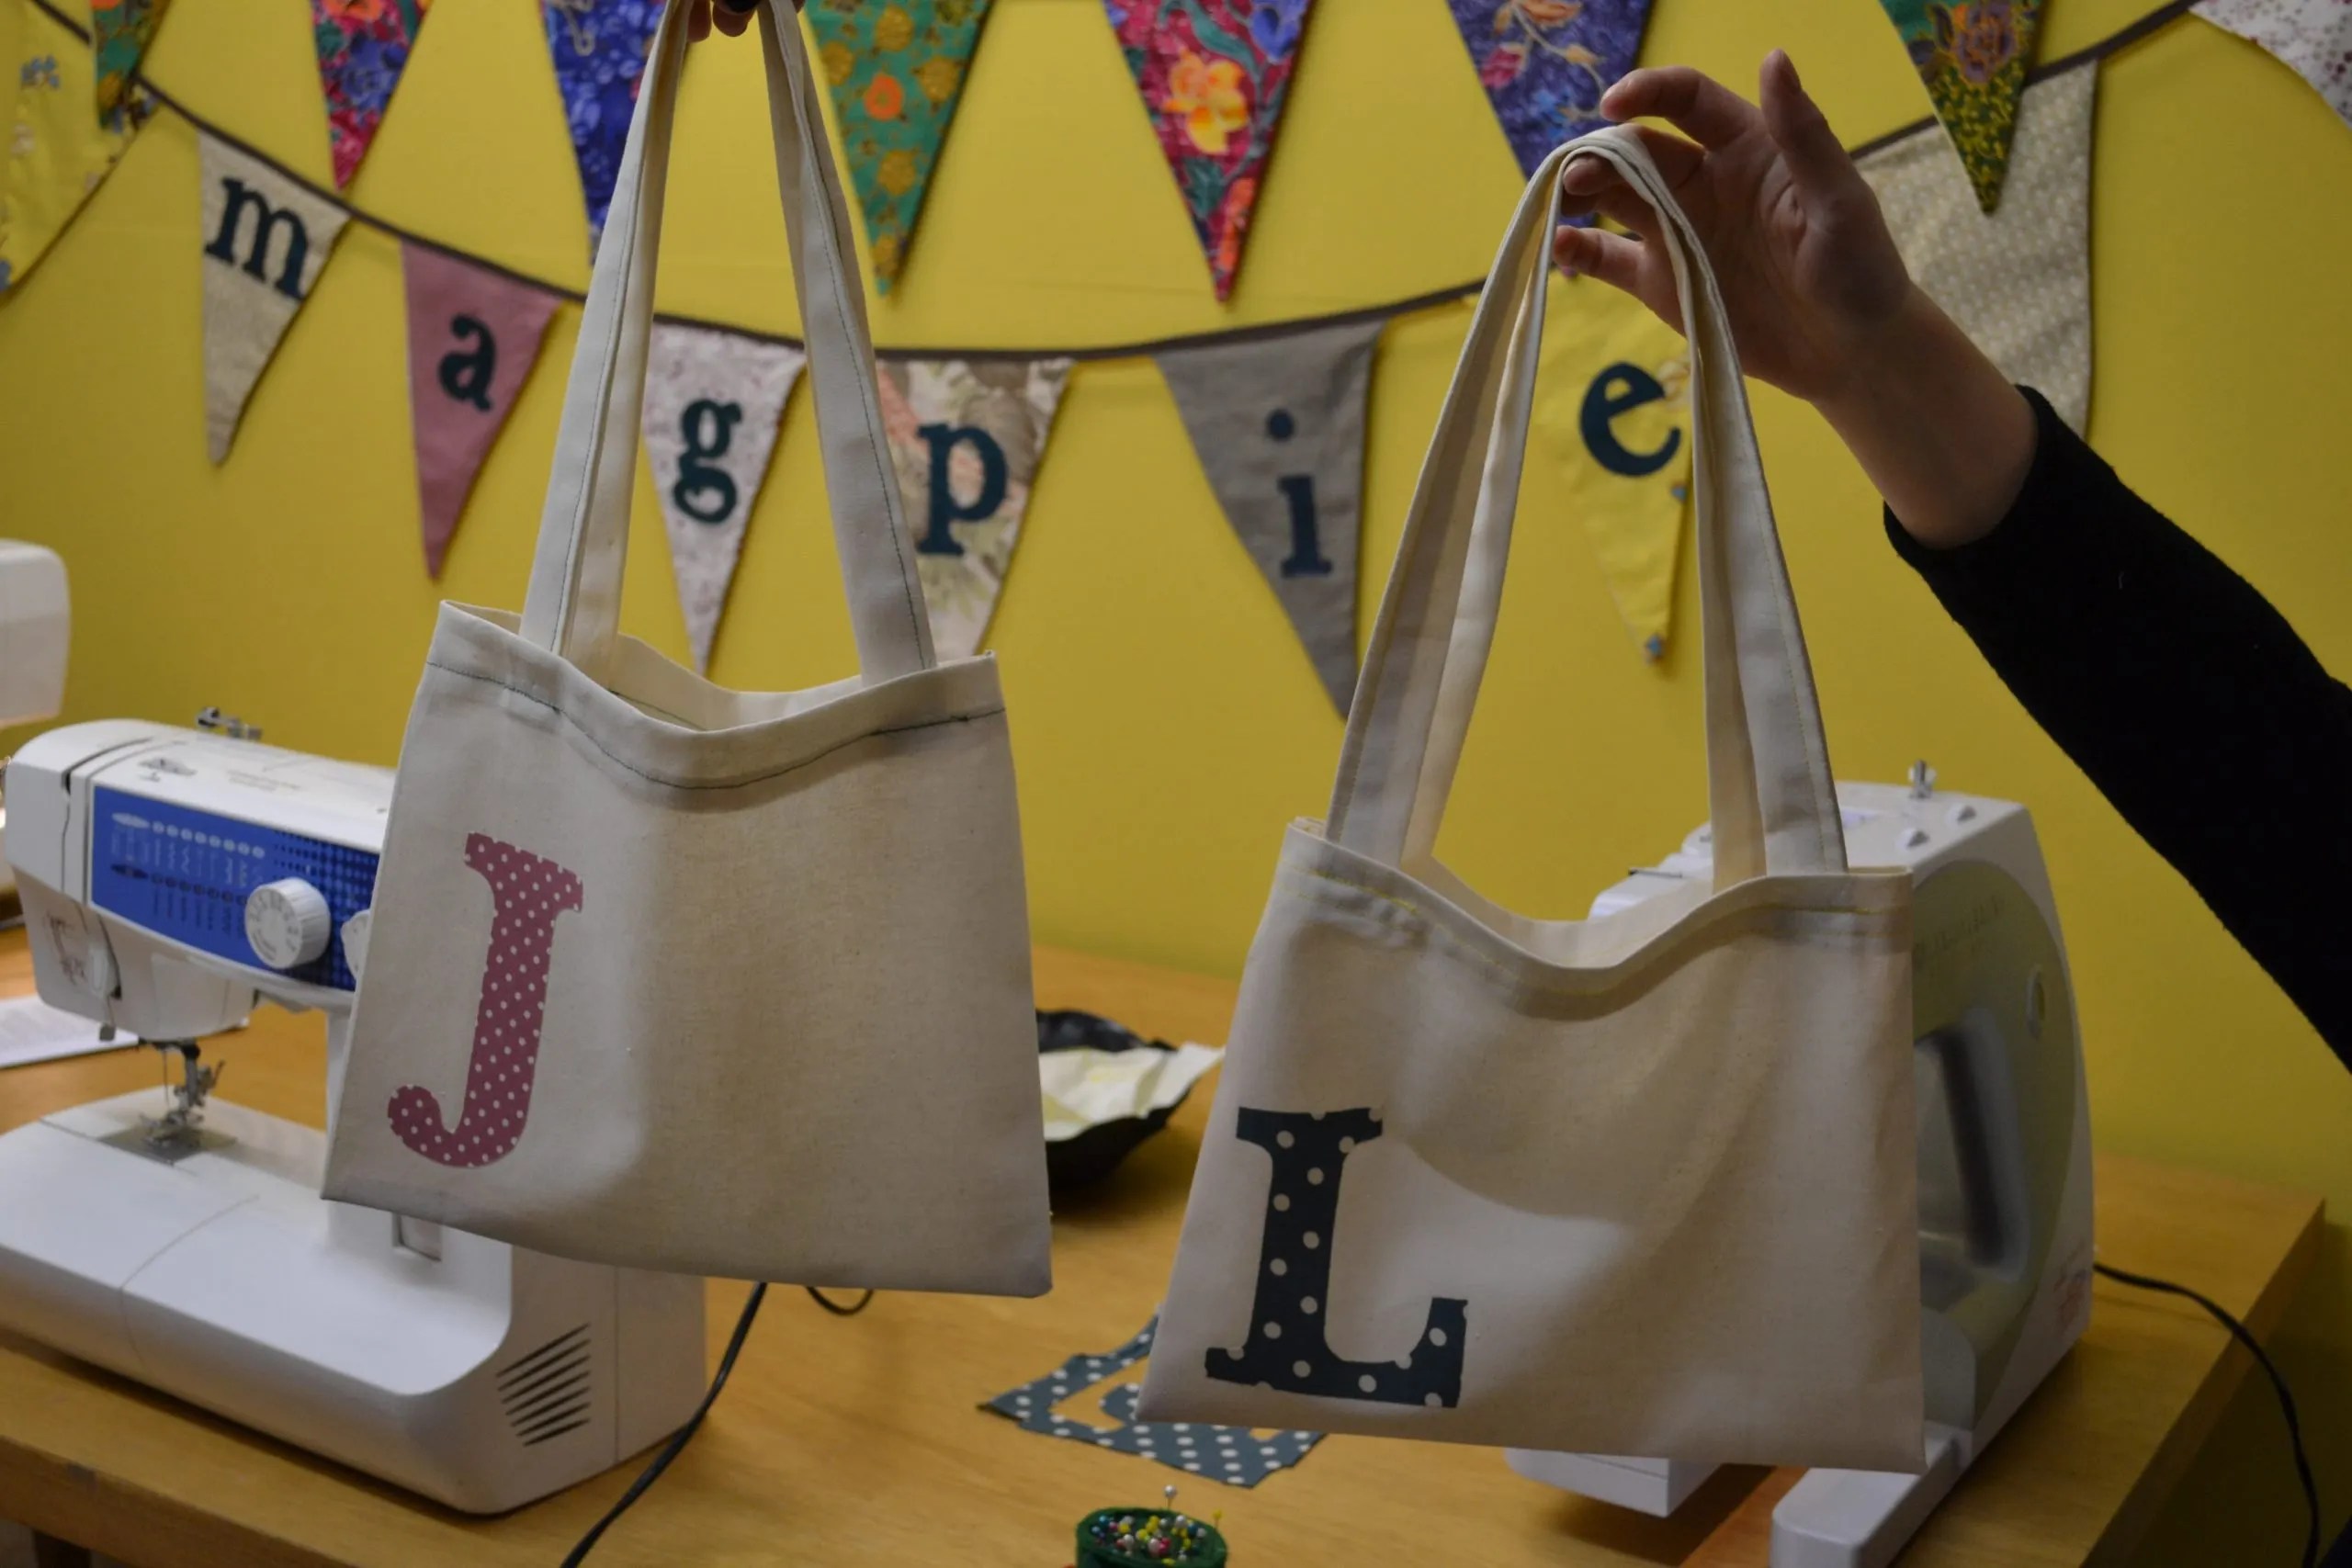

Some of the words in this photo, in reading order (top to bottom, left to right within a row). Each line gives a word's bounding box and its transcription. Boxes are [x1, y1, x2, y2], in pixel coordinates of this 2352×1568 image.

[204, 177, 309, 301] m
[437, 313, 496, 412] a
[673, 399, 742, 525] g
[915, 423, 1007, 557] p
[1580, 362, 1681, 477] e
[388, 832, 583, 1168] J
[1204, 1106, 1468, 1407] L
